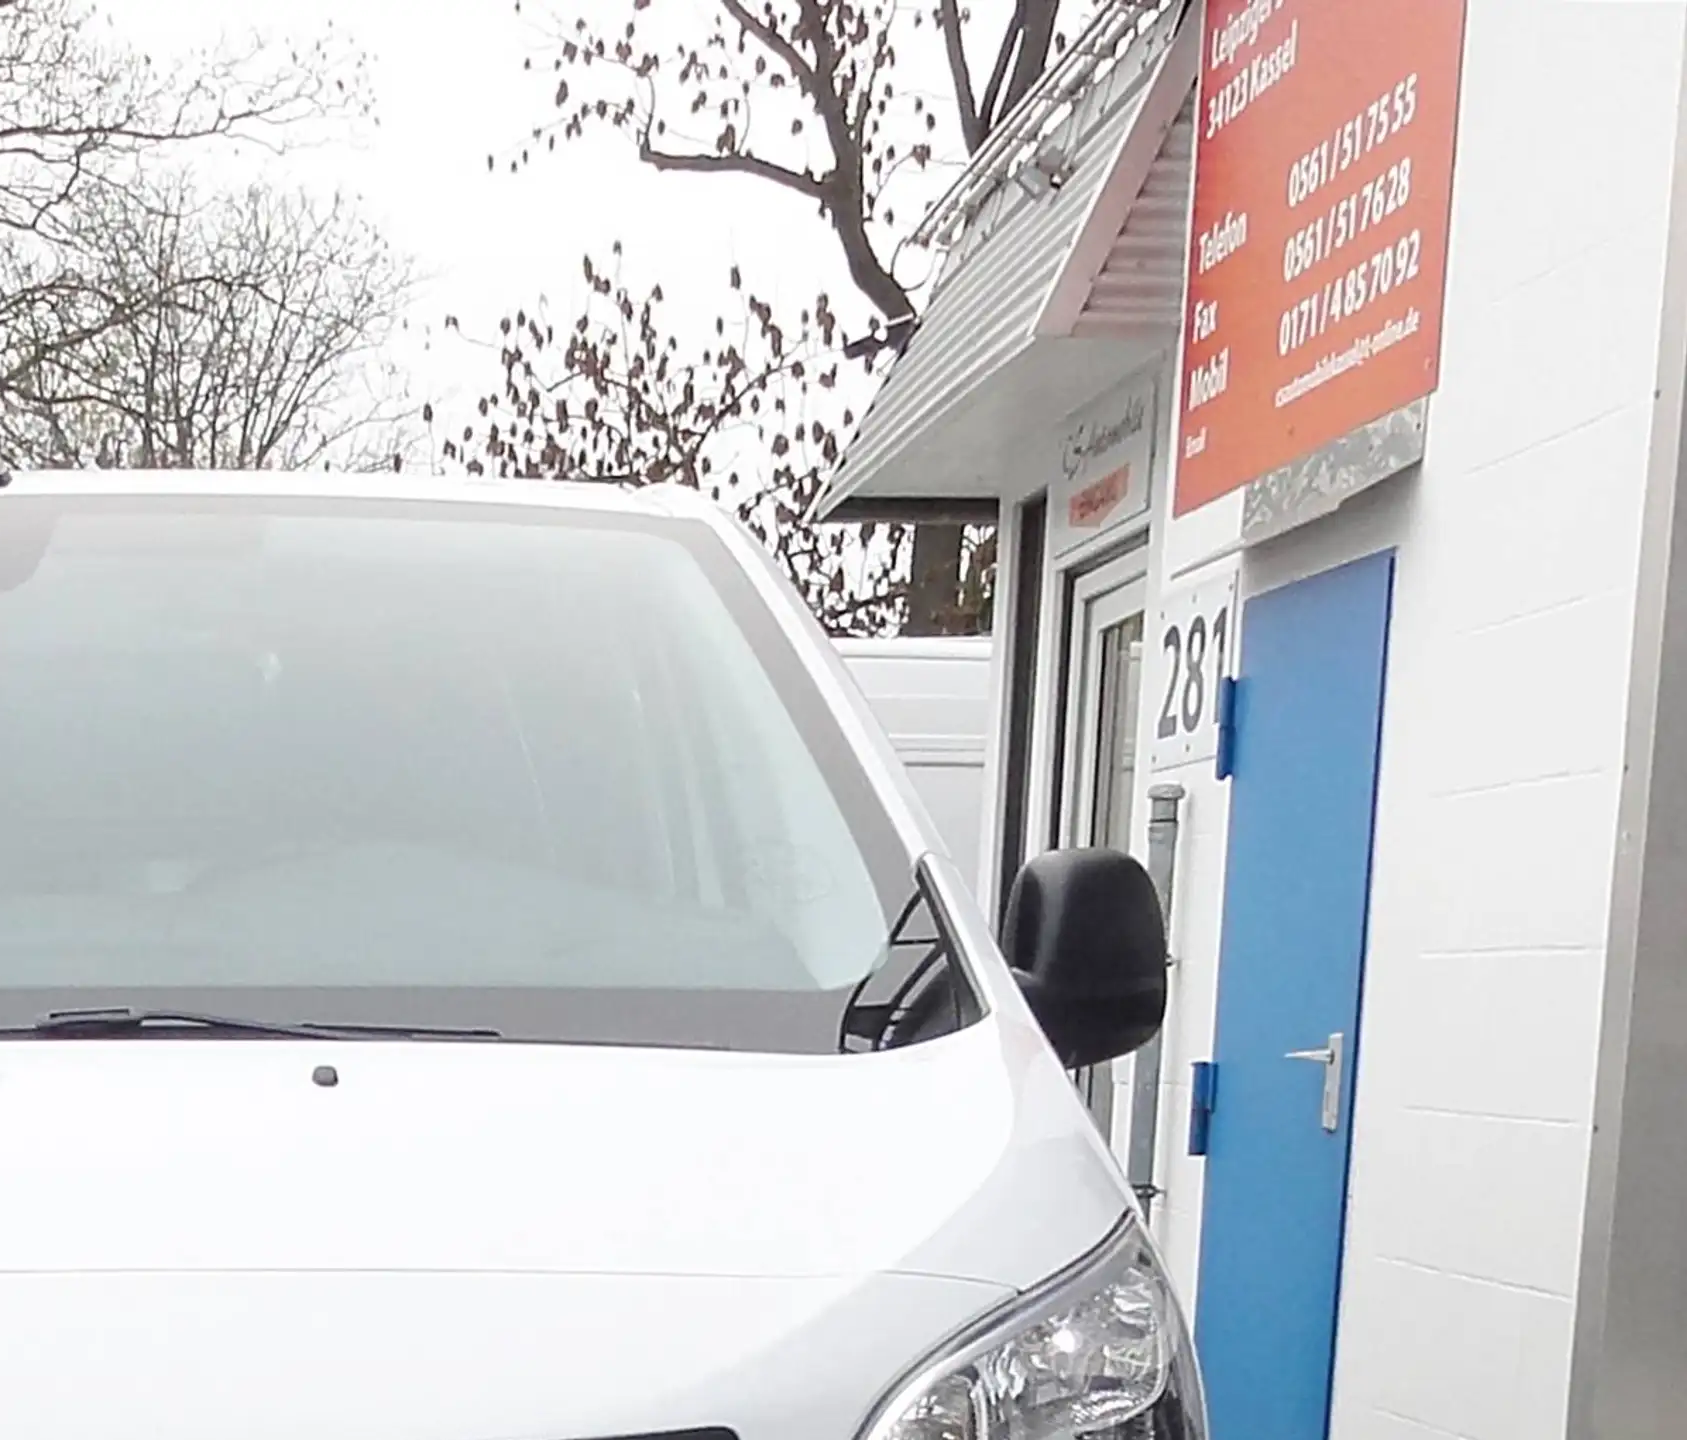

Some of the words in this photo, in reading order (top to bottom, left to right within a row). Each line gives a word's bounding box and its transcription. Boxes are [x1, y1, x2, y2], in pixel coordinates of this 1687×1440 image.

[1206, 67, 1248, 139] 34123
[1249, 19, 1298, 102] Kassel
[1199, 210, 1248, 275] Telefon
[1192, 300, 1218, 345] Fax
[1188, 345, 1230, 412] Mobil
[1157, 606, 1227, 740] 281
